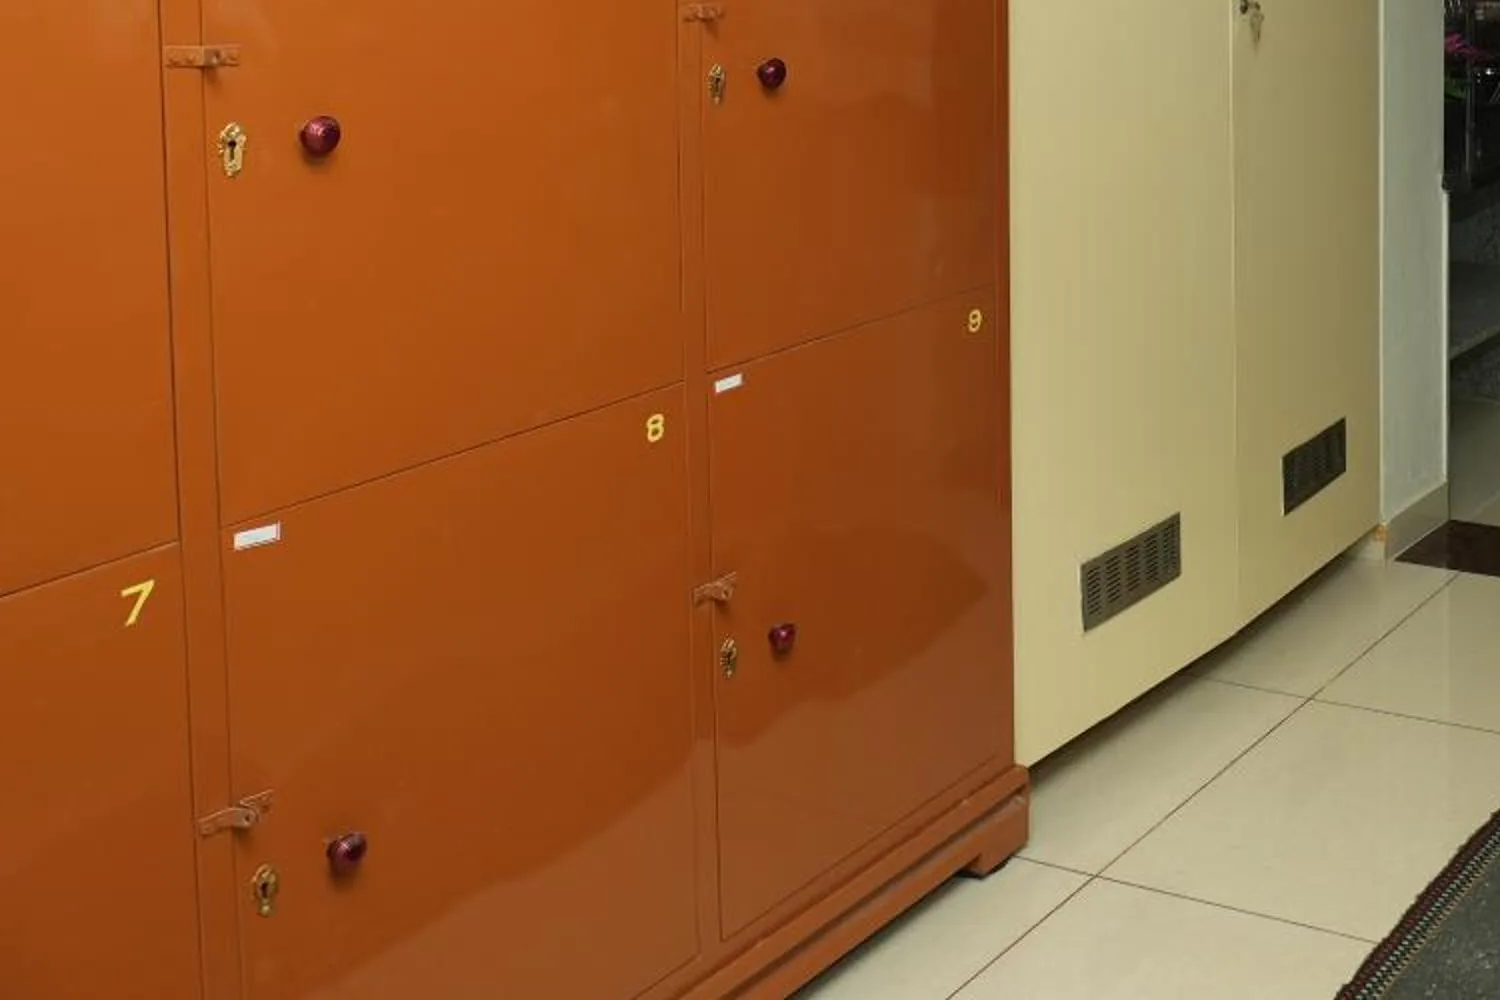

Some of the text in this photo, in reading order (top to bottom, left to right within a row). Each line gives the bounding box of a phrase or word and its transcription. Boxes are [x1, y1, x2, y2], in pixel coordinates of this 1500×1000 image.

[967, 309, 983, 333] 9
[646, 413, 665, 443] 8
[120, 579, 155, 626] 7
